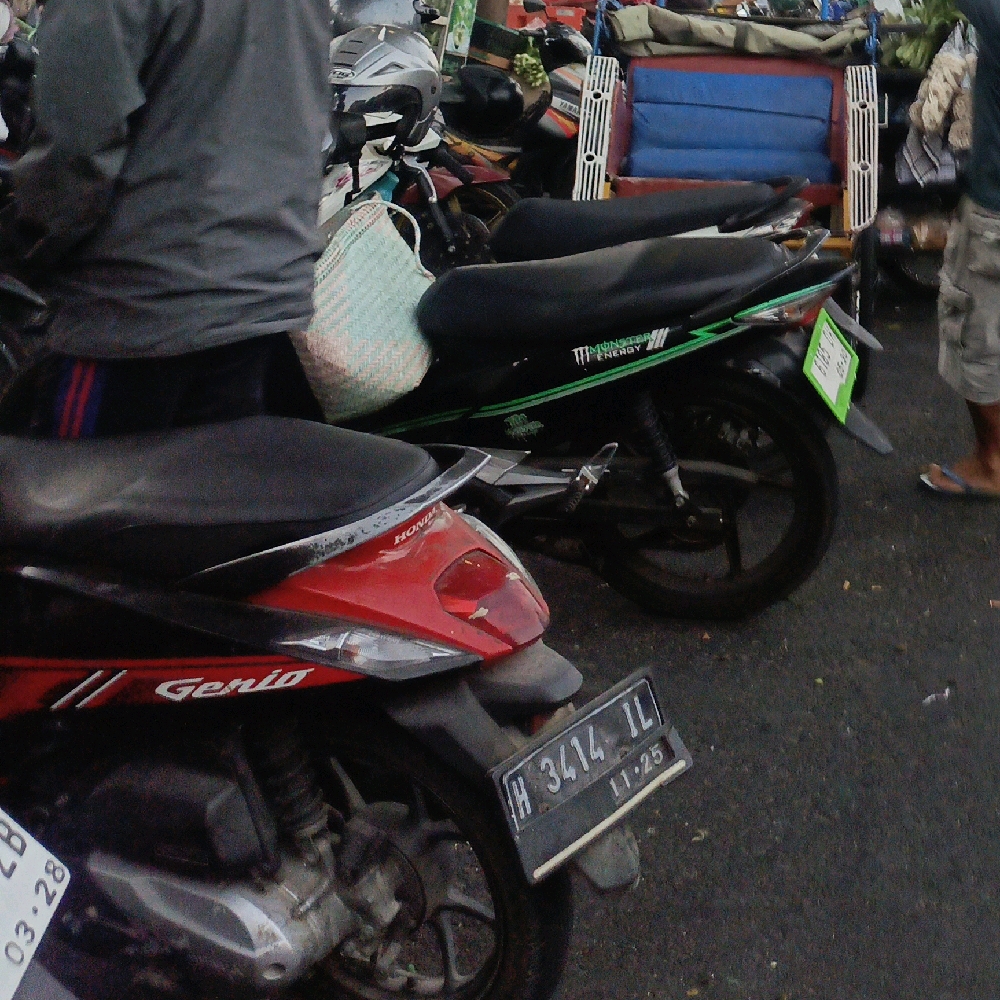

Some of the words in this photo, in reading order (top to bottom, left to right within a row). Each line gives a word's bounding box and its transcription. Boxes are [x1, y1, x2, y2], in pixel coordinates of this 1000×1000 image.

[560, 101, 580, 115] YAMA
[597, 345, 641, 361] ENERGY
[155, 668, 315, 702] Genio
[512, 775, 532, 820] H
[540, 725, 605, 793] 3414
[609, 743, 664, 797] 11.25
[5, 858, 66, 966] 03.28
